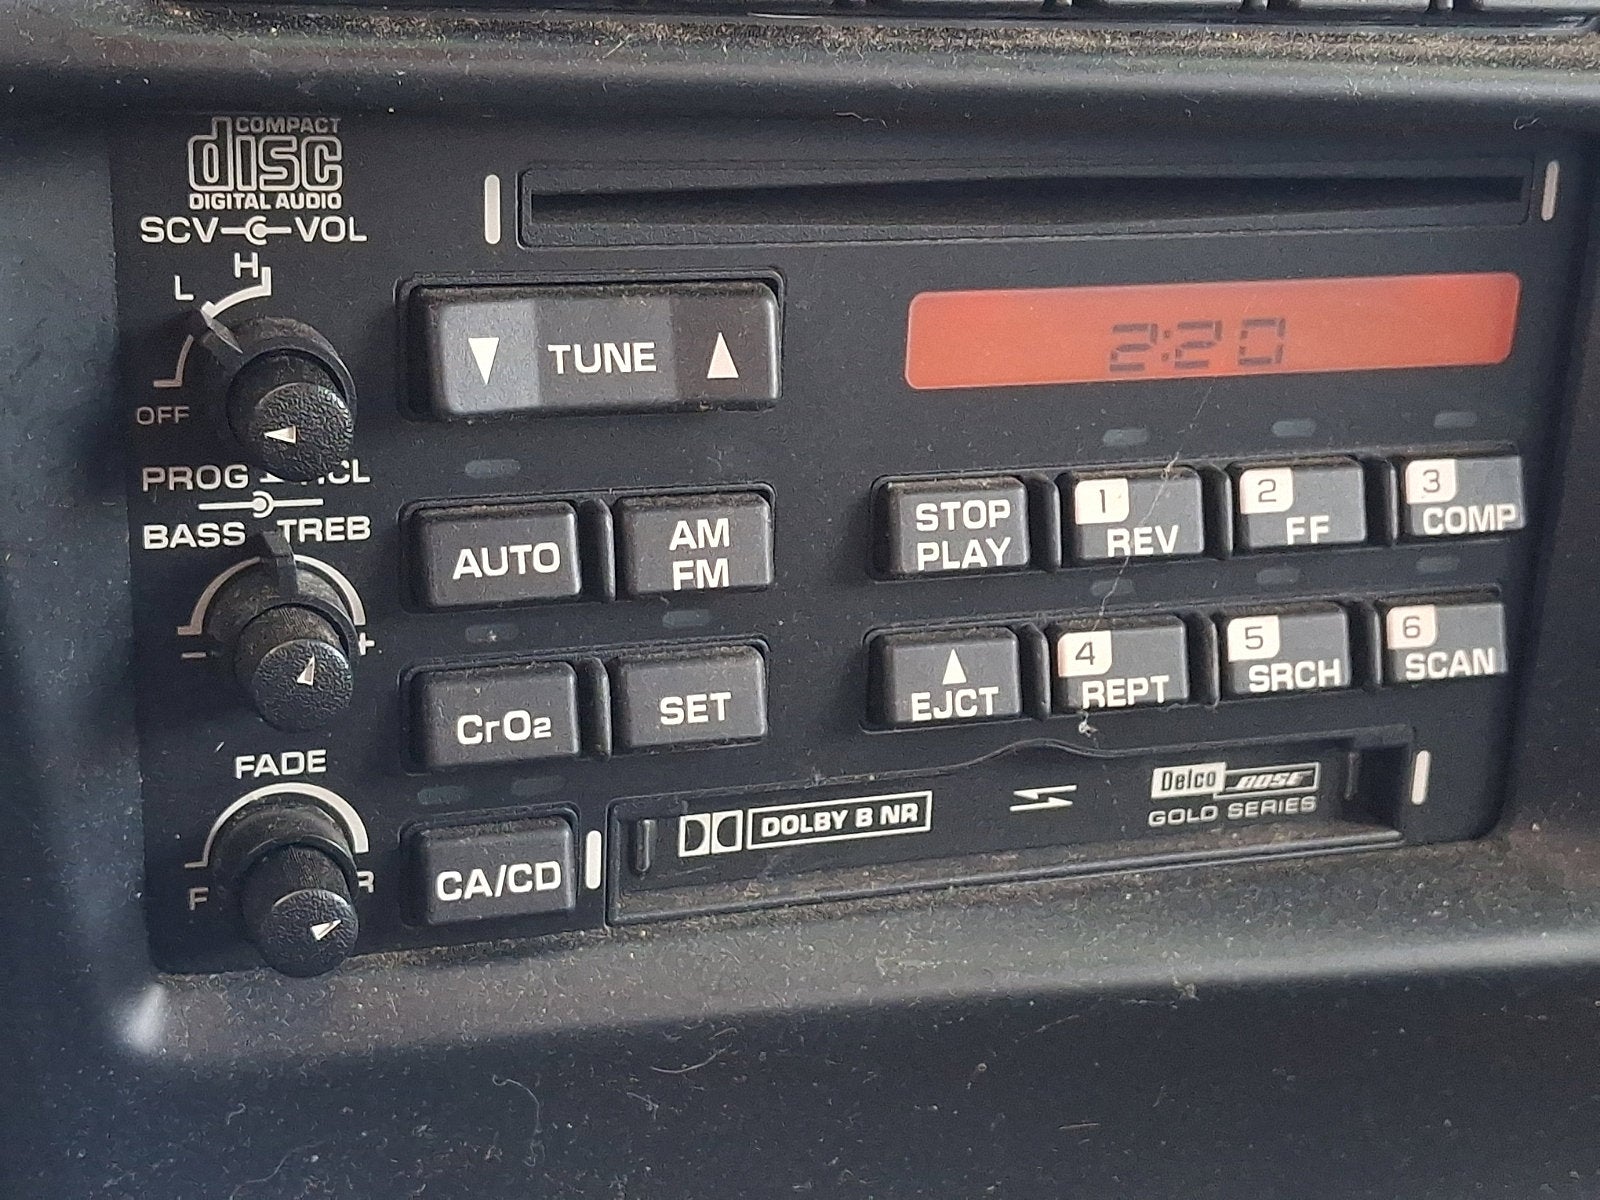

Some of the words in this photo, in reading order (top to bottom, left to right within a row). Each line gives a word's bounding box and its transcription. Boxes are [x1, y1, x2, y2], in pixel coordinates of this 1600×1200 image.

[234, 117, 342, 133] COMPACT
[189, 192, 271, 210] DIGITAL
[275, 192, 342, 209] AUDIO
[140, 216, 219, 243] SCV
[294, 215, 368, 242] VOL
[233, 252, 259, 278] H
[174, 275, 194, 300] L
[547, 342, 657, 375] TUNE
[1109, 317, 1287, 373] 2:20
[136, 405, 190, 425] OFF
[142, 464, 249, 491] PROG
[300, 459, 371, 486] CL
[1257, 479, 1277, 503] 2
[1422, 469, 1440, 493] 3
[915, 499, 1011, 531] STOP
[1099, 489, 1107, 514] 1
[143, 521, 246, 550] BASS
[276, 515, 371, 543] TREB
[669, 518, 731, 550] AM
[1286, 515, 1329, 545] FF
[1422, 503, 1516, 535] COMP
[916, 537, 1011, 571] PLAY
[1107, 525, 1179, 557] REV
[452, 542, 562, 579] AUTO
[672, 558, 731, 591] FM
[1244, 626, 1264, 650] 5
[1402, 615, 1421, 639] 6
[1075, 641, 1096, 666] 4
[1404, 648, 1495, 681] SCAN
[1082, 675, 1170, 709] REPT
[1248, 659, 1341, 693] SRCH
[659, 691, 732, 725] SET
[911, 687, 999, 722] EJCT
[235, 749, 327, 779] FADE
[1161, 769, 1217, 791] Delco
[761, 810, 849, 838] DOLBY
[855, 807, 874, 828] B
[879, 802, 919, 825] NR
[1148, 805, 1219, 827] GOLD
[1227, 796, 1318, 820] SERIES
[436, 860, 563, 901] CA/CD
[188, 888, 209, 910] F
